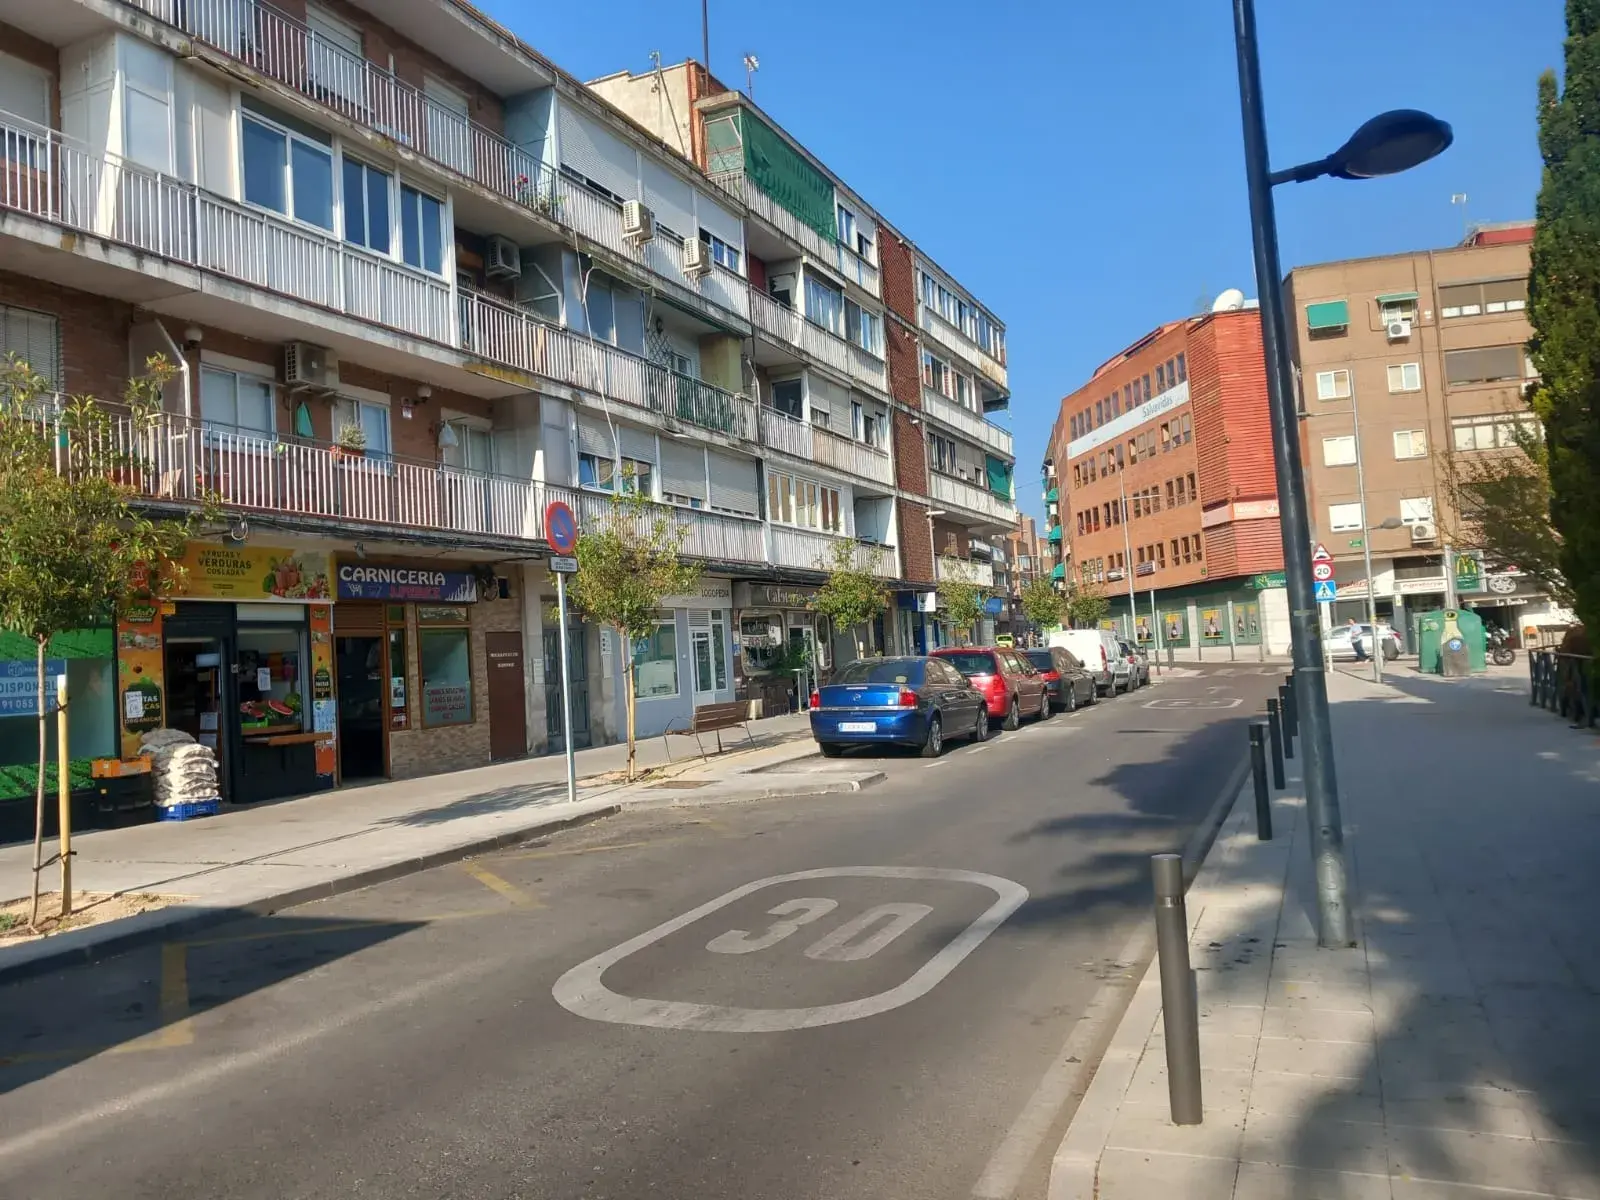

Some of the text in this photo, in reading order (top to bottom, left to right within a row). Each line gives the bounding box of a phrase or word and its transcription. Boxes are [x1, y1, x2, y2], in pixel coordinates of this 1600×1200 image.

[207, 550, 234, 558] FRUTAS
[198, 558, 251, 569] VERDURAS
[207, 568, 240, 576] COSLADA
[1317, 567, 1329, 575] 20
[340, 566, 445, 586] CARNICERIA
[706, 897, 933, 961] 30
